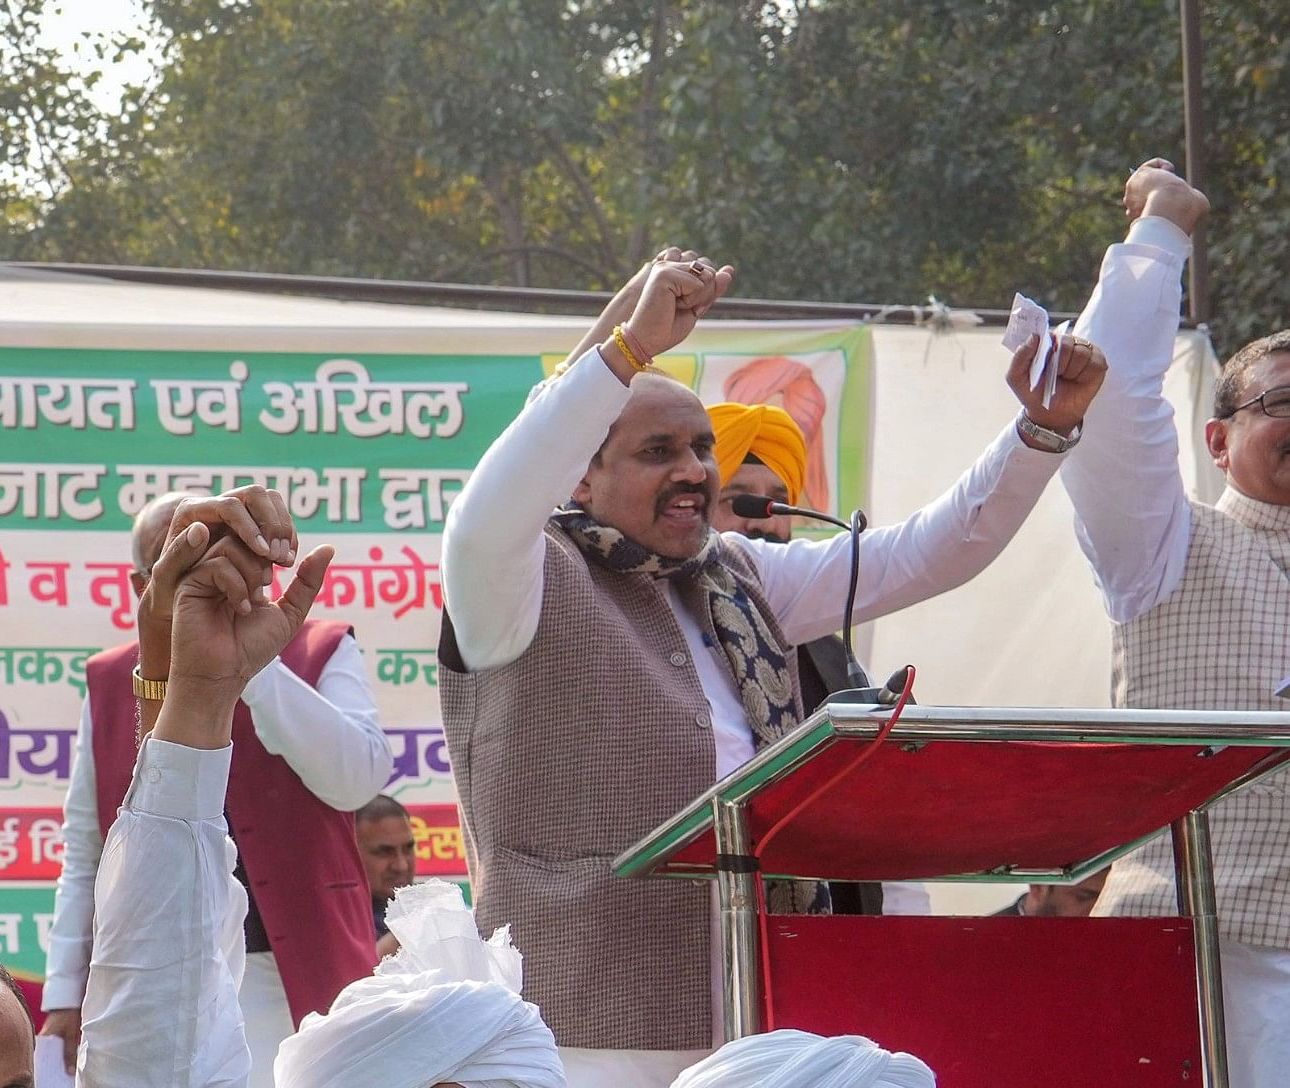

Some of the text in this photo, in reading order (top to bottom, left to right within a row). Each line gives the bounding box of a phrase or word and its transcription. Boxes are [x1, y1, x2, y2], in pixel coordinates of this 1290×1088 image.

[150, 360, 250, 435] एवं
[259, 359, 469, 438] अखिल
[26, 563, 70, 607] व
[315, 545, 443, 619] कांग्रे
